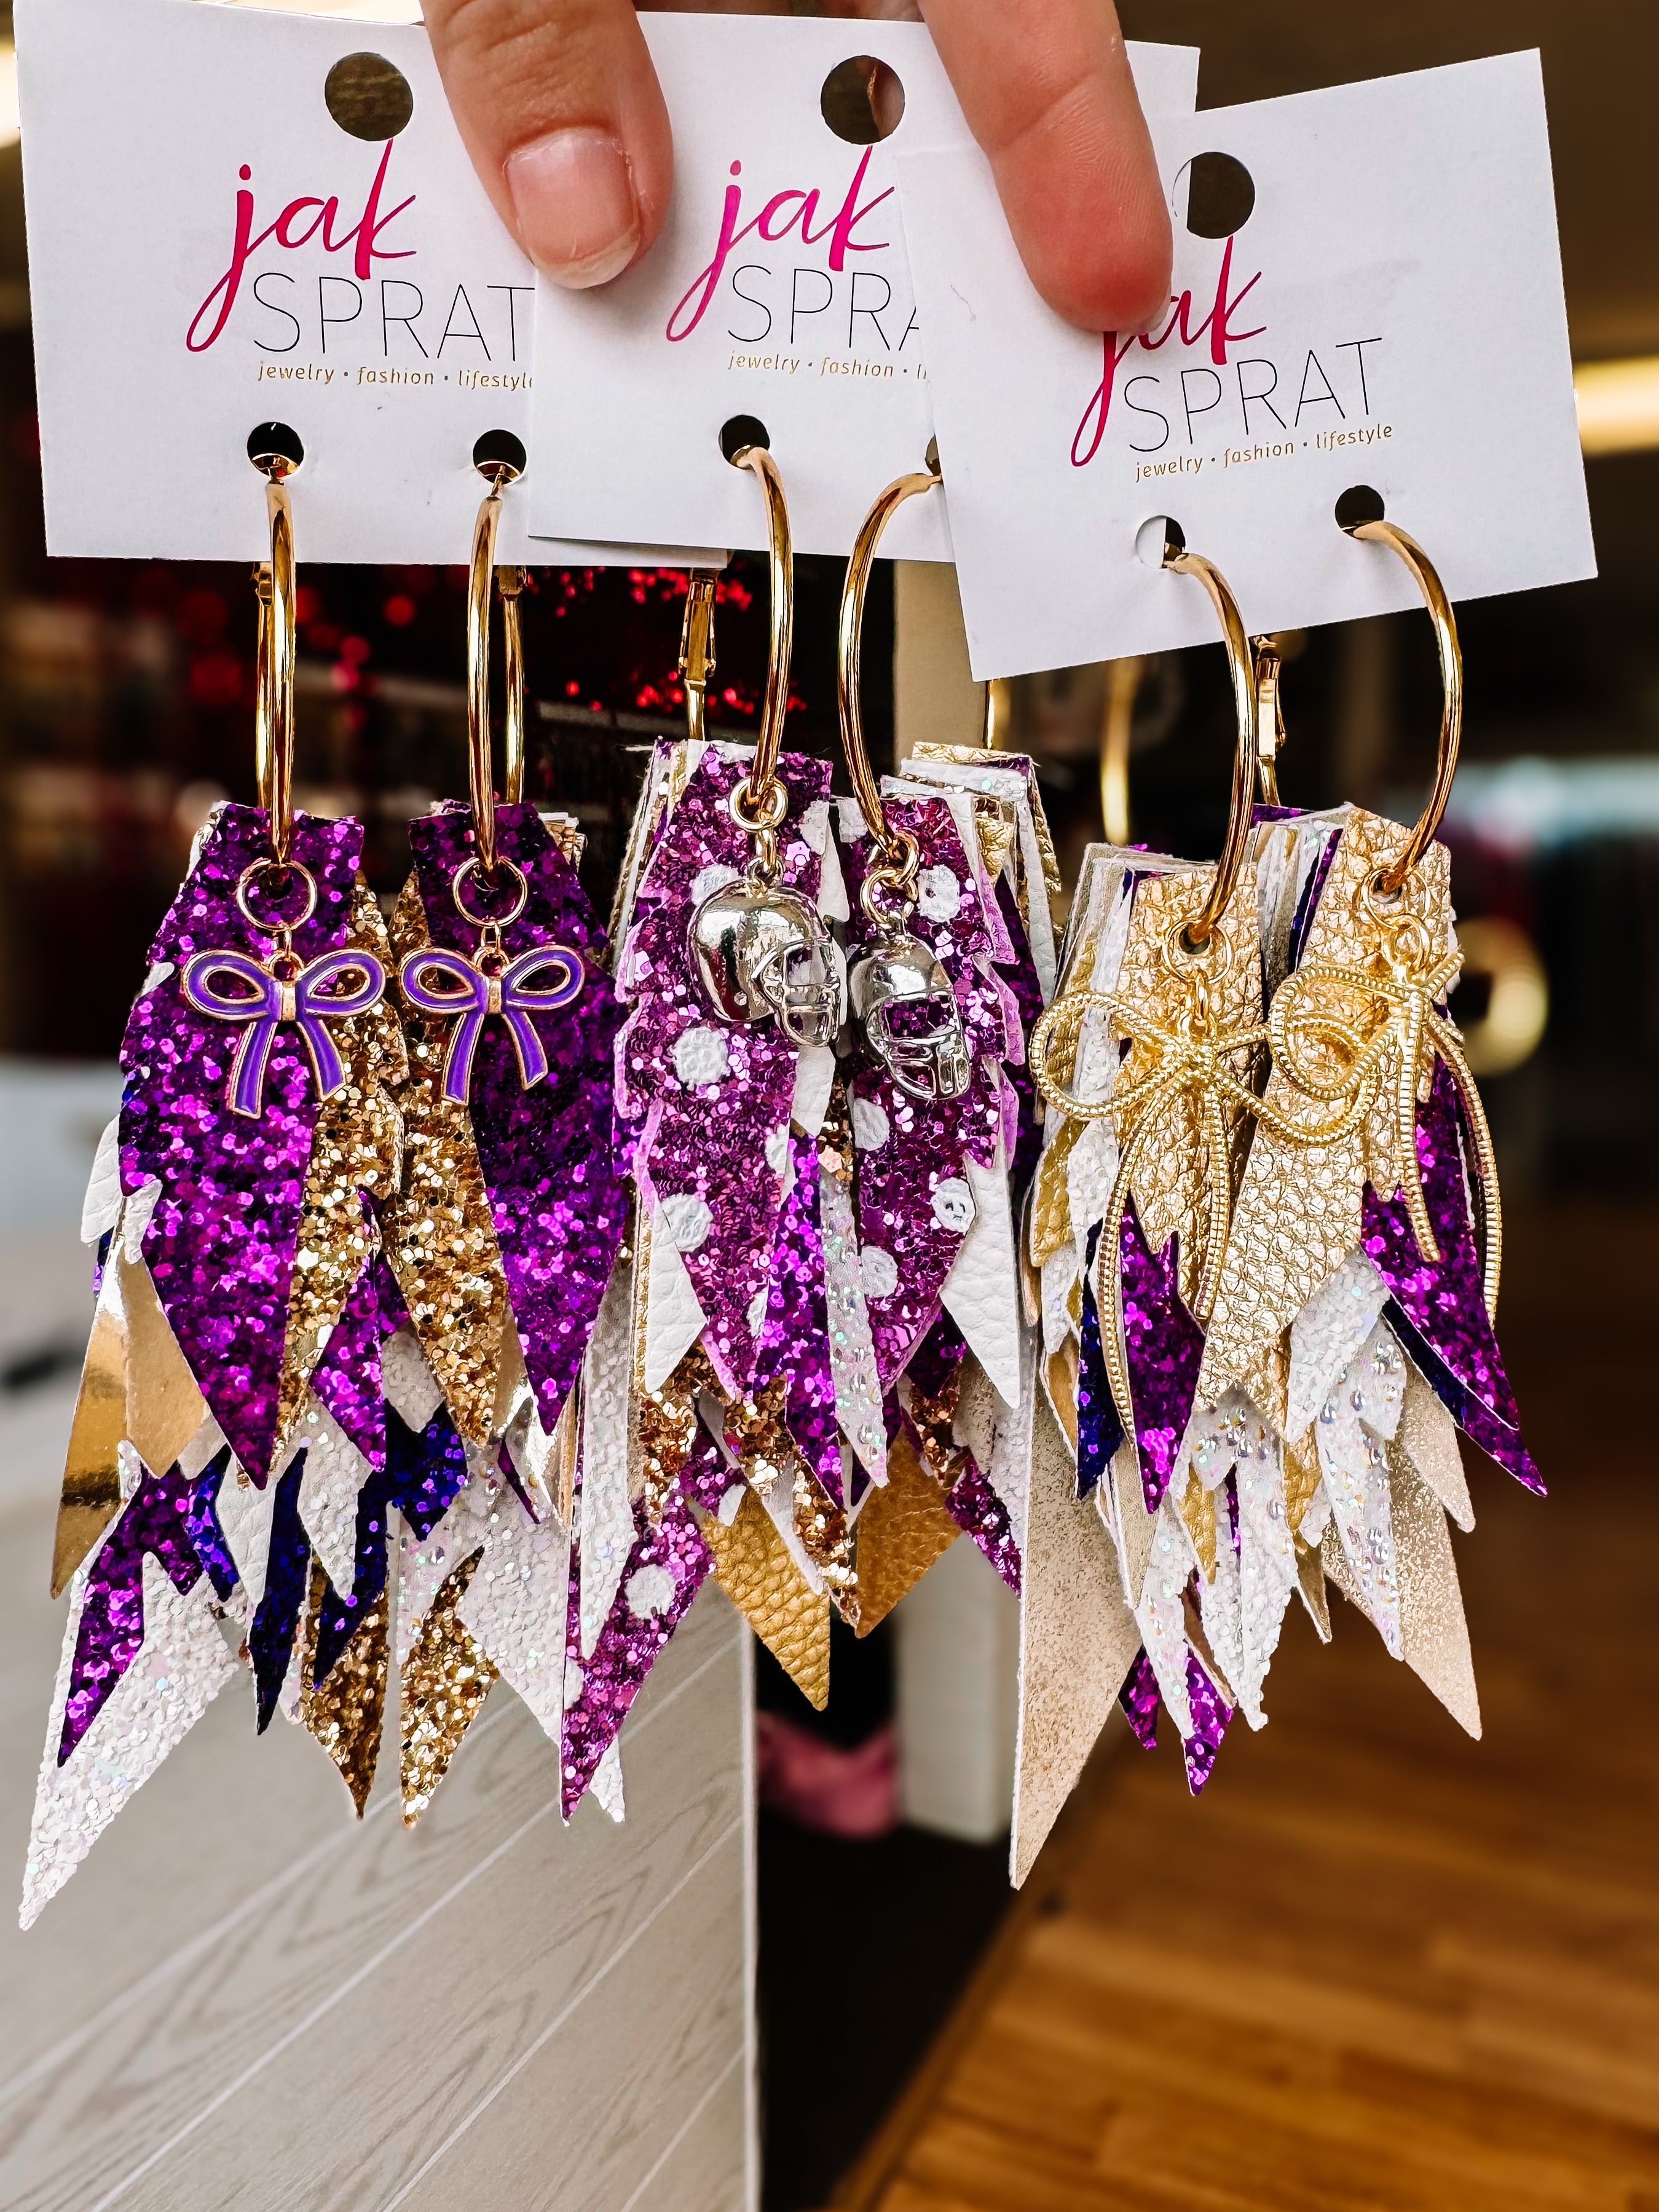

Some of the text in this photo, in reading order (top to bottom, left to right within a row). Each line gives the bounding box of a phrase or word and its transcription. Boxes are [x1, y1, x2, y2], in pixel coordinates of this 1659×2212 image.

[186, 138, 417, 352] jak
[666, 145, 895, 342] jak
[253, 272, 535, 361] SPRAT
[728, 265, 920, 352] SPR
[258, 361, 334, 384] jewelry
[357, 366, 434, 385] fashion
[728, 351, 800, 372] jewelry
[819, 356, 894, 377] fashion
[1124, 337, 1382, 452] SPRAT
[1135, 423, 1392, 483] jewelry fashion lifestyle
